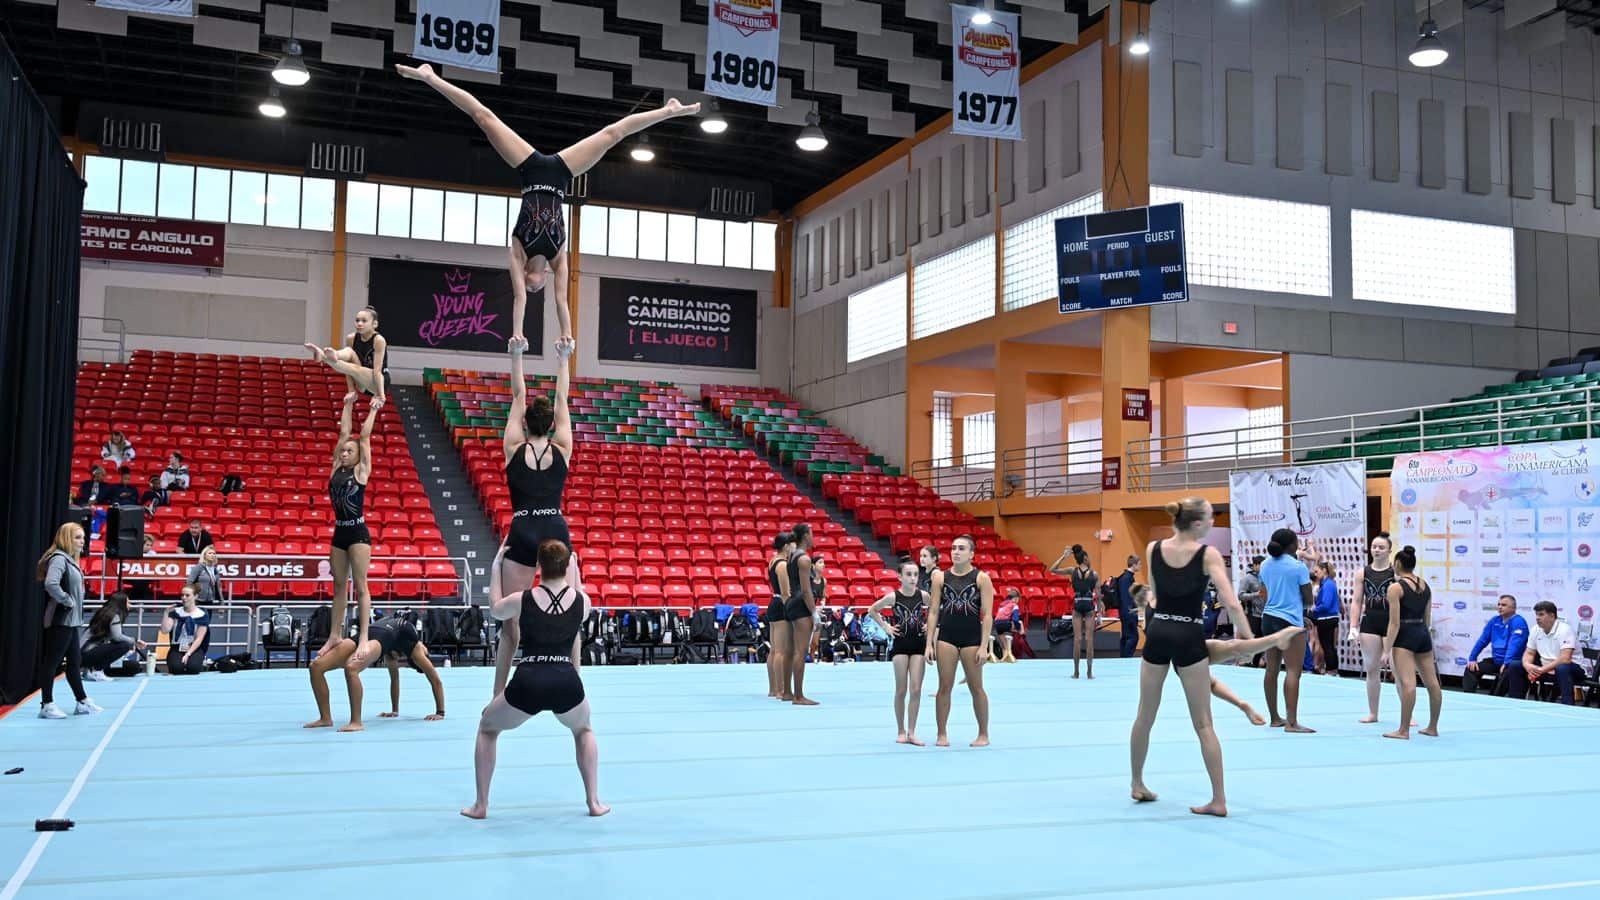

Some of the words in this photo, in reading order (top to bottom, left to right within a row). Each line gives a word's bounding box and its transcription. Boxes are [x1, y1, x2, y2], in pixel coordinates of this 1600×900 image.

[721, 10, 771, 28] CAMPEONAS
[420, 13, 495, 56] 1989
[711, 51, 776, 91] 1980
[958, 91, 1018, 126] 1977
[137, 229, 214, 246] ANGULO
[1144, 230, 1176, 243] GUEST
[109, 242, 127, 250] DE
[131, 243, 193, 255] CAROLINA
[1063, 241, 1089, 253] HOME
[1107, 241, 1129, 250] PERIOD
[1100, 271, 1124, 281] PLAYER
[1125, 269, 1141, 279] FOUL
[1160, 264, 1182, 274] FOULS
[1060, 276, 1080, 285] FOULS
[1110, 297, 1132, 306] MATCH
[1162, 291, 1184, 301] SCORE
[432, 292, 485, 319] YOUNG
[1061, 302, 1081, 311] SCORE
[627, 305, 731, 324] CAMBIANDO
[419, 312, 504, 345] QUEENZ
[642, 331, 661, 344] EL
[664, 334, 718, 348] JUEGO
[1506, 459, 1588, 472] PANAMERICANA
[1277, 477, 1292, 486] was
[116, 562, 180, 576] PALCO
[245, 561, 304, 576] LOPÉS
